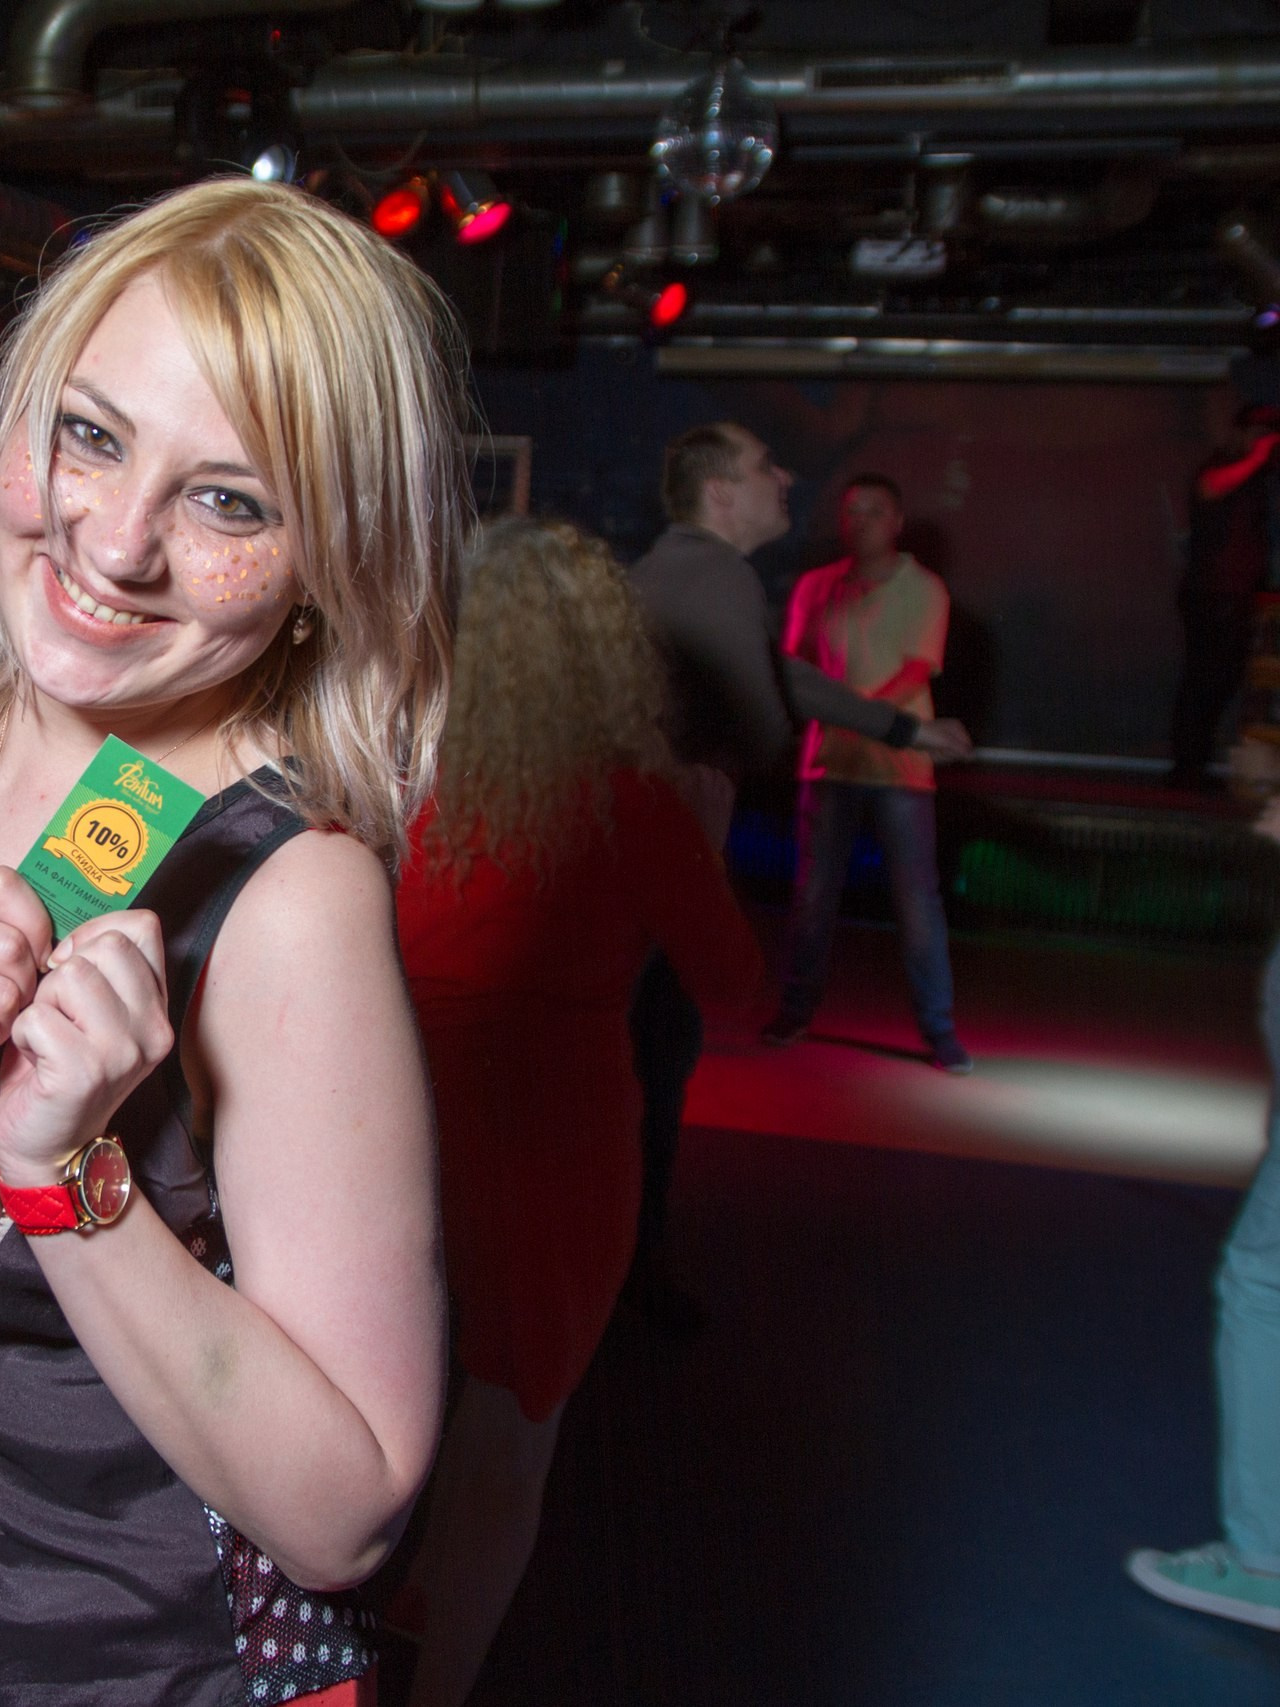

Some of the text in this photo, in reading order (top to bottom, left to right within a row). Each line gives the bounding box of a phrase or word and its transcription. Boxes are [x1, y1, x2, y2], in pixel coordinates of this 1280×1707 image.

[87, 820, 129, 859] 10%
[35, 861, 49, 875] НА
[71, 849, 103, 882] СКИДКА
